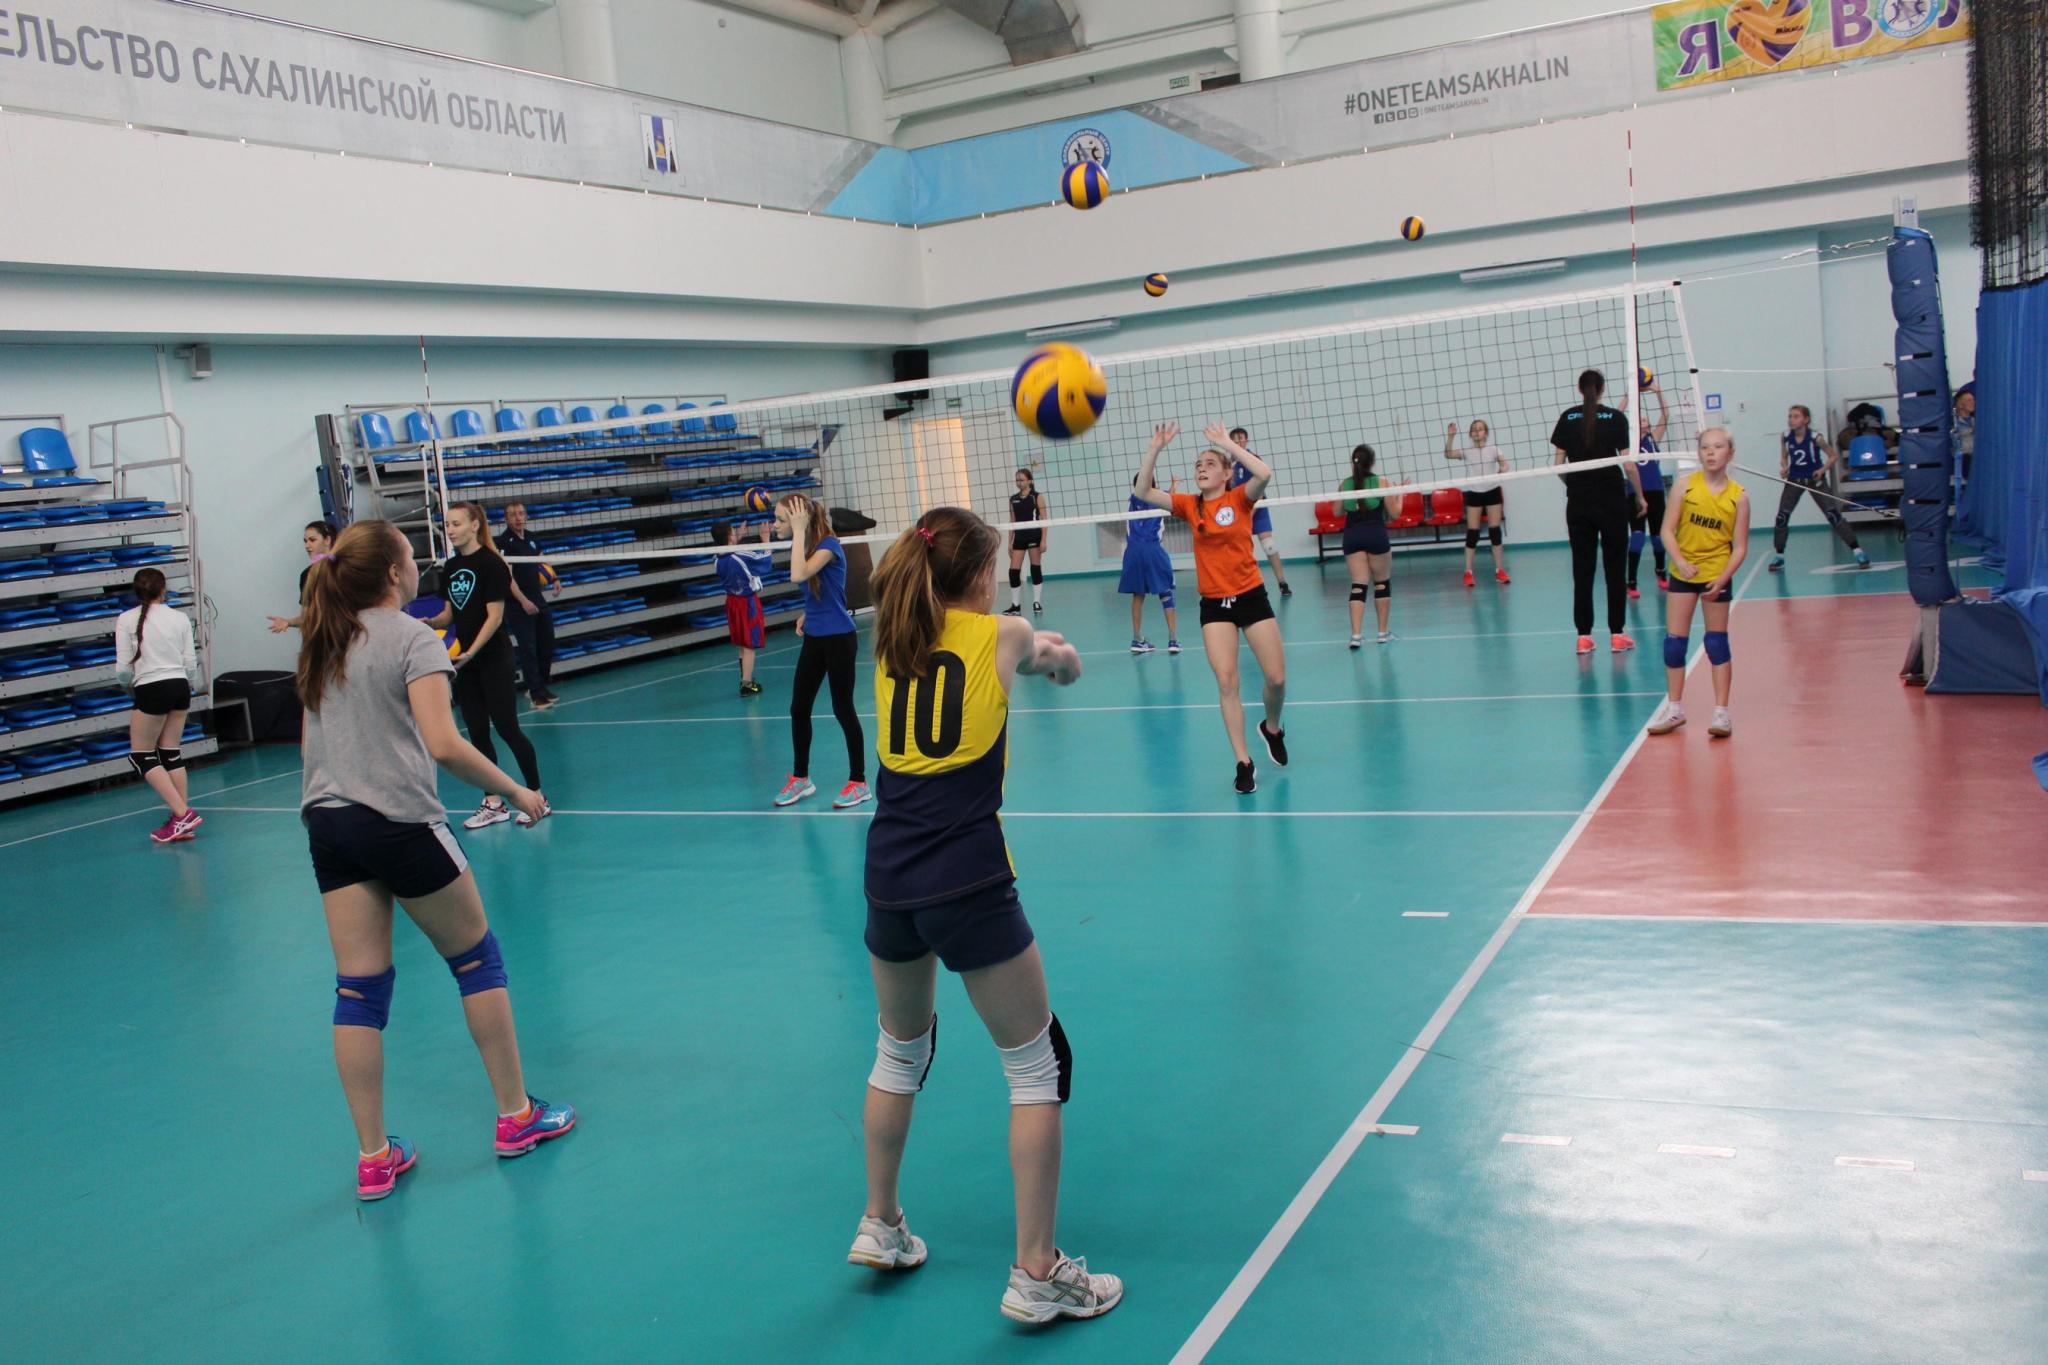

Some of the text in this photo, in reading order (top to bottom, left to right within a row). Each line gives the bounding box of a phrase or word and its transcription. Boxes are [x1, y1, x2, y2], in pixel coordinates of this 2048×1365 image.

[1677, 20, 1722, 76] Я
[192, 47, 440, 125] САХАЛИНСКОЙ
[447, 92, 568, 145] ОБЛАСТИ
[1344, 56, 1570, 115] #ONETEAMSAKHALIN
[1793, 449, 1808, 466] 2
[886, 650, 966, 758] 10
